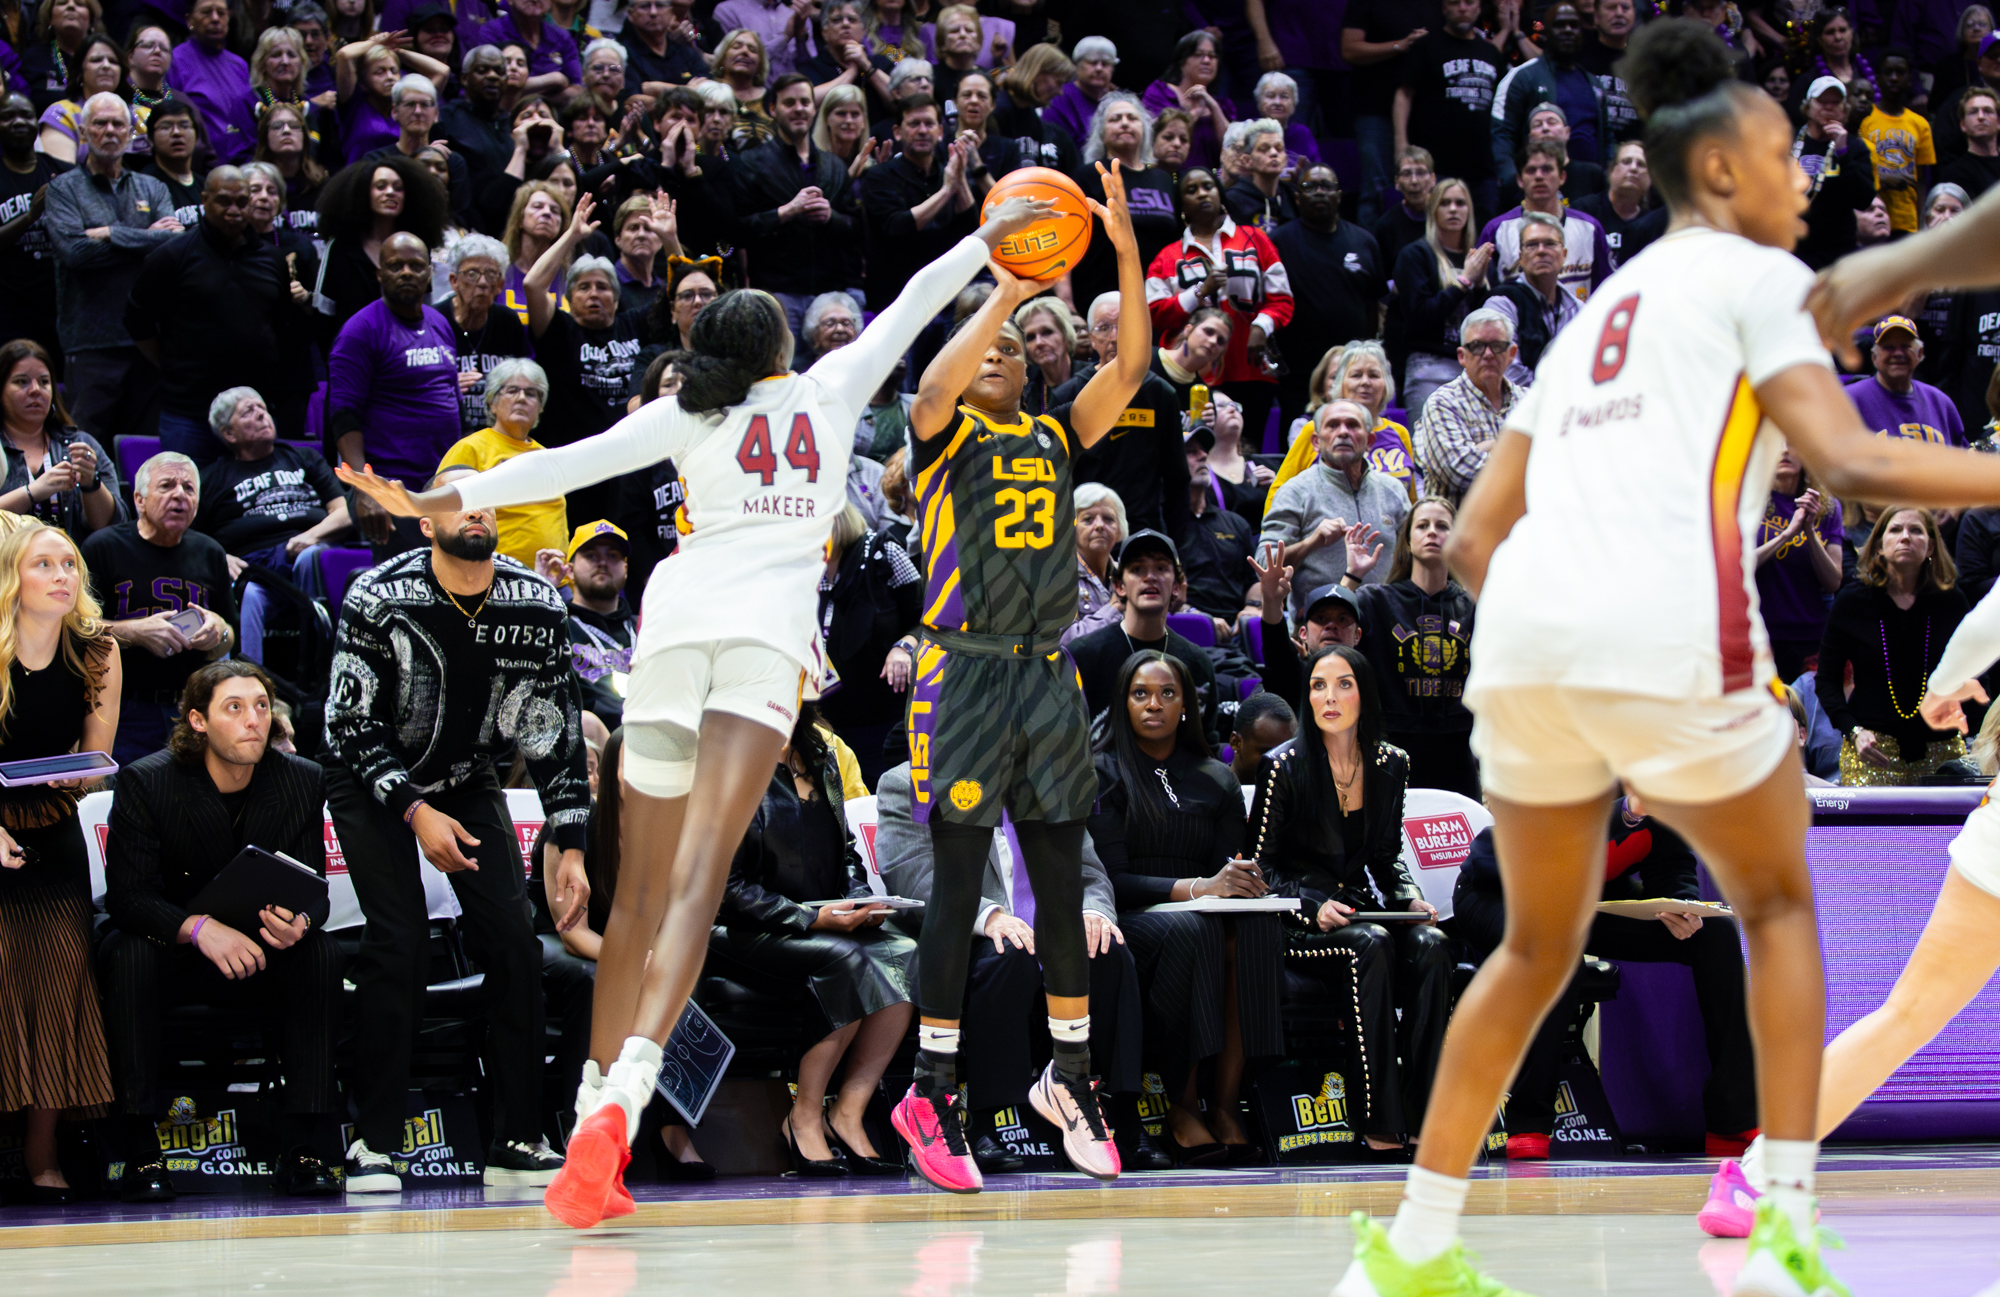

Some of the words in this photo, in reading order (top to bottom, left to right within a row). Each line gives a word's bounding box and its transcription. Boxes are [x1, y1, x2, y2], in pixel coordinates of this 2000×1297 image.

[0, 192, 33, 224] DEAF
[1000, 231, 1059, 256] ELITE
[1591, 292, 1641, 387] 8
[405, 346, 439, 367] TIGERS
[735, 412, 820, 487] 44
[993, 455, 1057, 481] LSU
[234, 471, 272, 501] DEAF
[743, 495, 815, 518] MAKEER
[994, 487, 1056, 549] 23
[115, 577, 209, 621] LSU
[475, 624, 489, 643] E
[494, 625, 554, 647] 07521
[908, 701, 932, 804] LSU
[1815, 797, 1850, 810] Energy
[1423, 819, 1464, 835] FARM
[1415, 832, 1469, 850] BUREAU
[1430, 848, 1471, 861] INSURANC
[156, 1113, 233, 1152] engal
[1561, 1114, 1588, 1130] .com
[1279, 1132, 1318, 1152] KEEPS
[1319, 1131, 1355, 1144] PESTS
[1556, 1128, 1613, 1142] G.O.N.E.
[211, 1146, 248, 1162] .com
[420, 1146, 454, 1163] .com
[165, 1158, 200, 1172] ESTS
[200, 1161, 273, 1175] G.O.N.E.
[410, 1161, 481, 1177] G.O.N.E.
